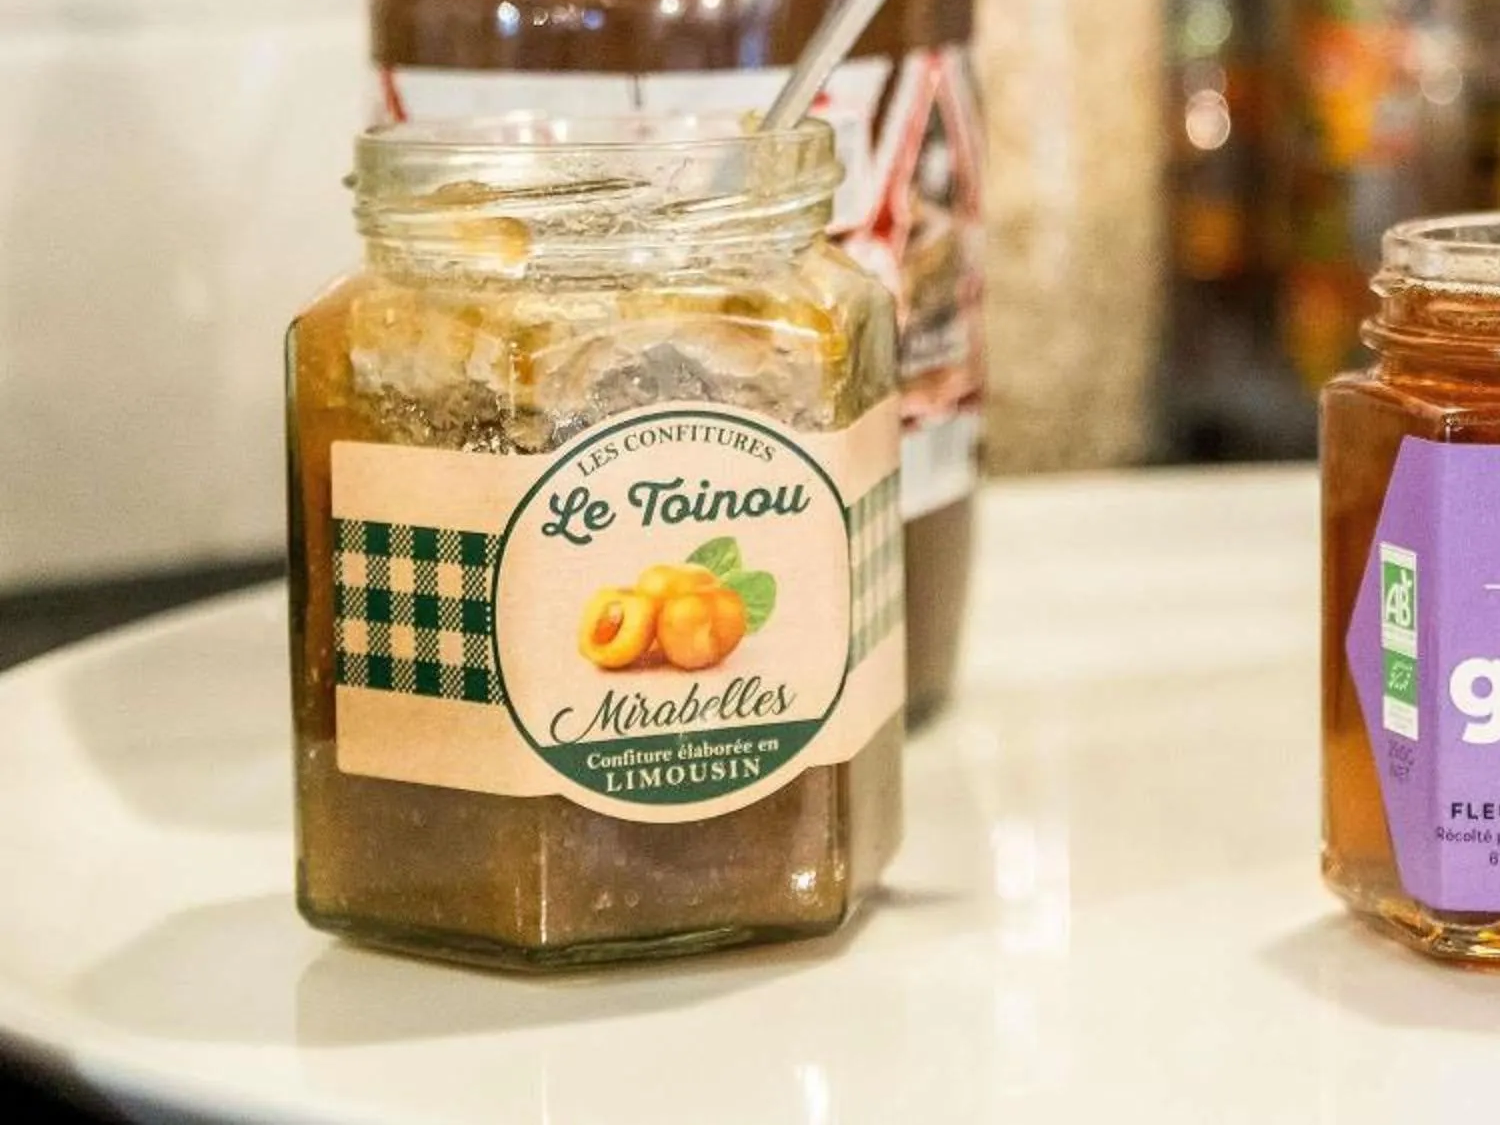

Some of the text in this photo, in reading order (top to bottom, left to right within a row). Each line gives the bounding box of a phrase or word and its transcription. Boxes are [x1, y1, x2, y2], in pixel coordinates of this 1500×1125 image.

[576, 424, 776, 477] LES CONFITURES
[541, 478, 810, 544] Le Toinou
[550, 676, 797, 744] Mirabelles
[586, 737, 780, 770] Confiture élaborée en
[606, 758, 762, 793] LIMOUSIN
